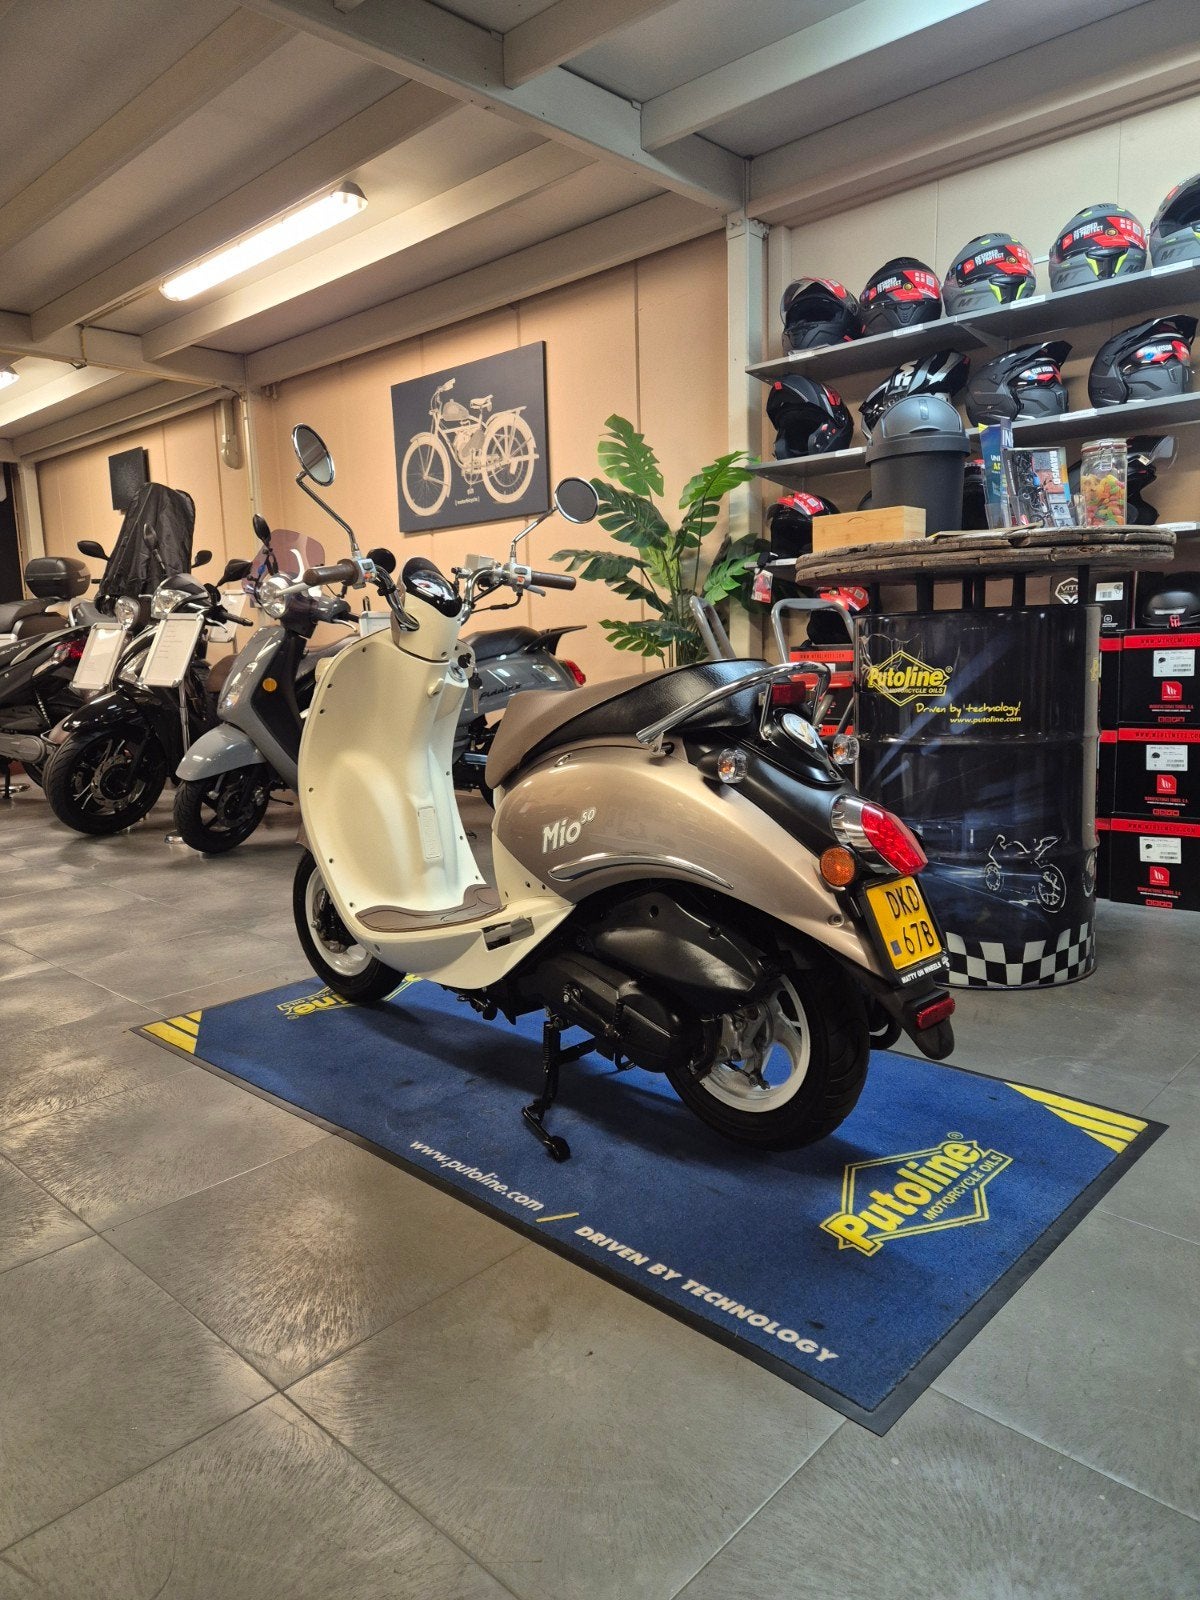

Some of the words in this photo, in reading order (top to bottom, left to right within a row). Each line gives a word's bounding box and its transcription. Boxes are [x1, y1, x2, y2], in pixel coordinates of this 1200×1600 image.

[868, 665, 944, 689] Putoline
[915, 702, 947, 714] Driven
[949, 703, 962, 717] by
[949, 715, 1022, 725] www.putoline.com
[542, 818, 582, 854] Mio
[884, 884, 921, 919] DKD
[901, 972, 918, 984] MATTY
[924, 961, 943, 974] WHEELS
[826, 1142, 982, 1251] Putoline
[921, 1169, 985, 1222] MOTORCYCLE
[978, 1154, 1004, 1174] OILS
[409, 1140, 545, 1212] www.putoline.com
[574, 1225, 650, 1266] DRIVEN
[646, 1262, 683, 1281] BY
[681, 1279, 840, 1363] TECHNOLOGY
